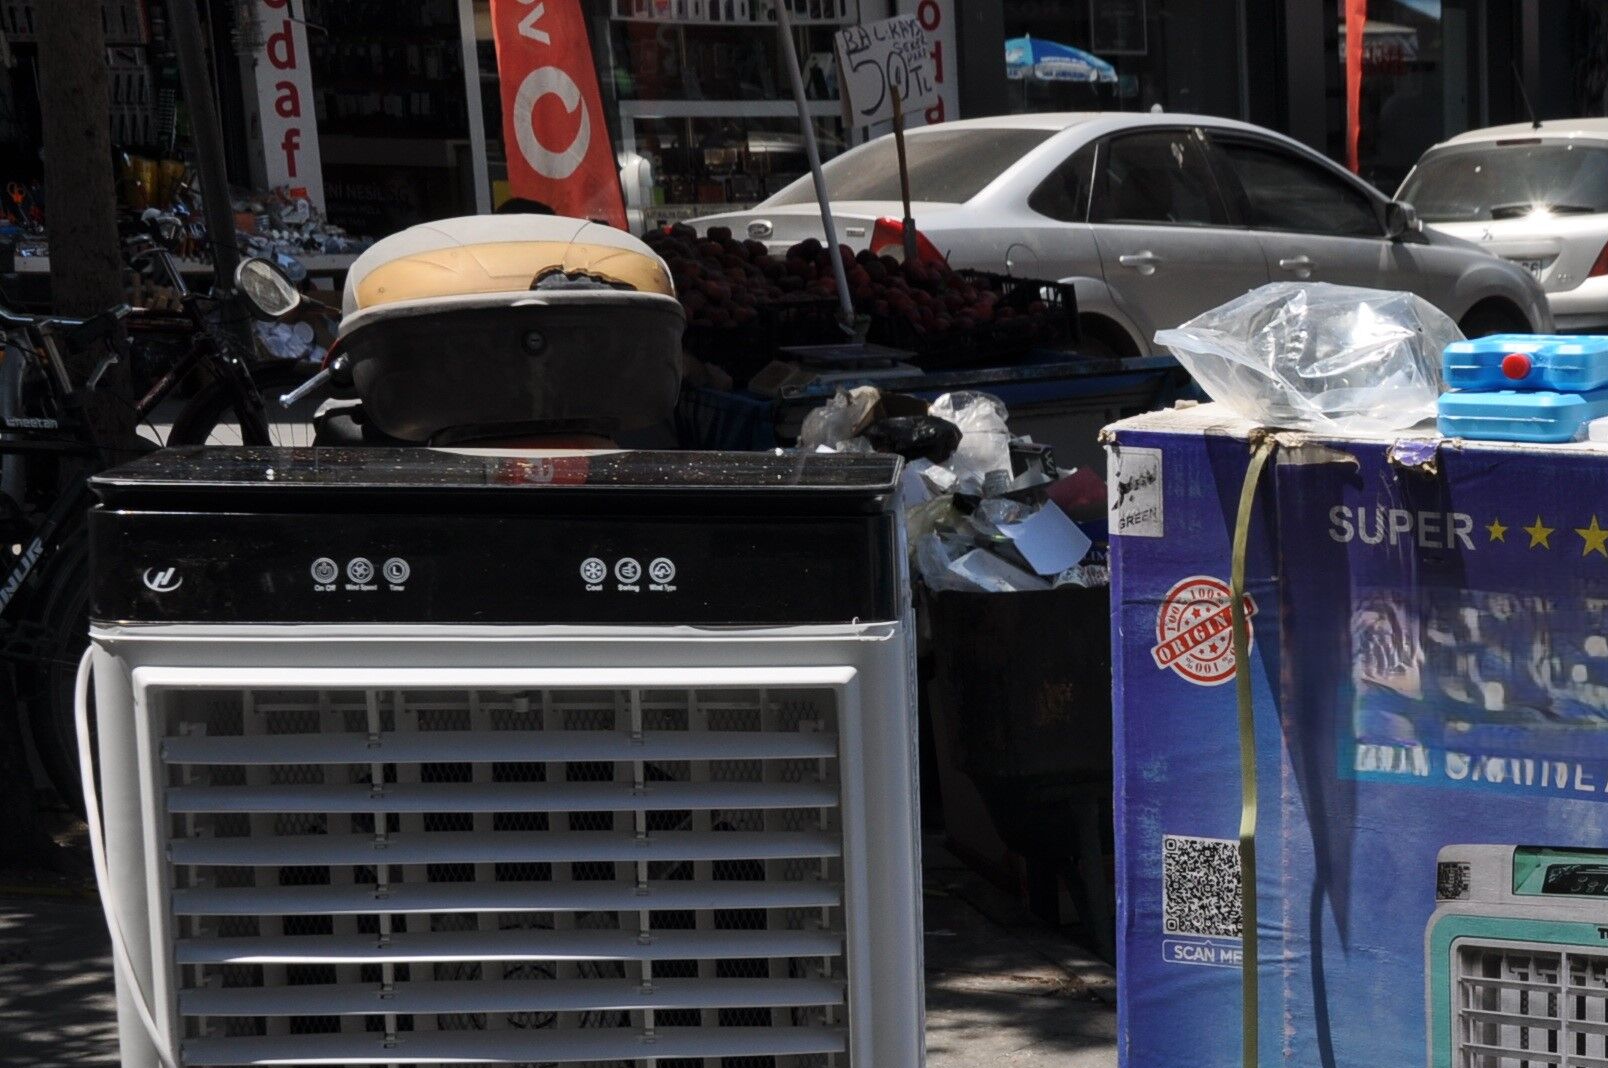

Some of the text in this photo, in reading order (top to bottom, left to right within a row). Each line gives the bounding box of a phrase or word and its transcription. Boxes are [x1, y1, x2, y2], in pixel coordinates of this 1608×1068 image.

[1328, 504, 1476, 550] SUPER
[1156, 596, 1252, 664] ORIGIN
[1174, 944, 1244, 965] SCAN ME
